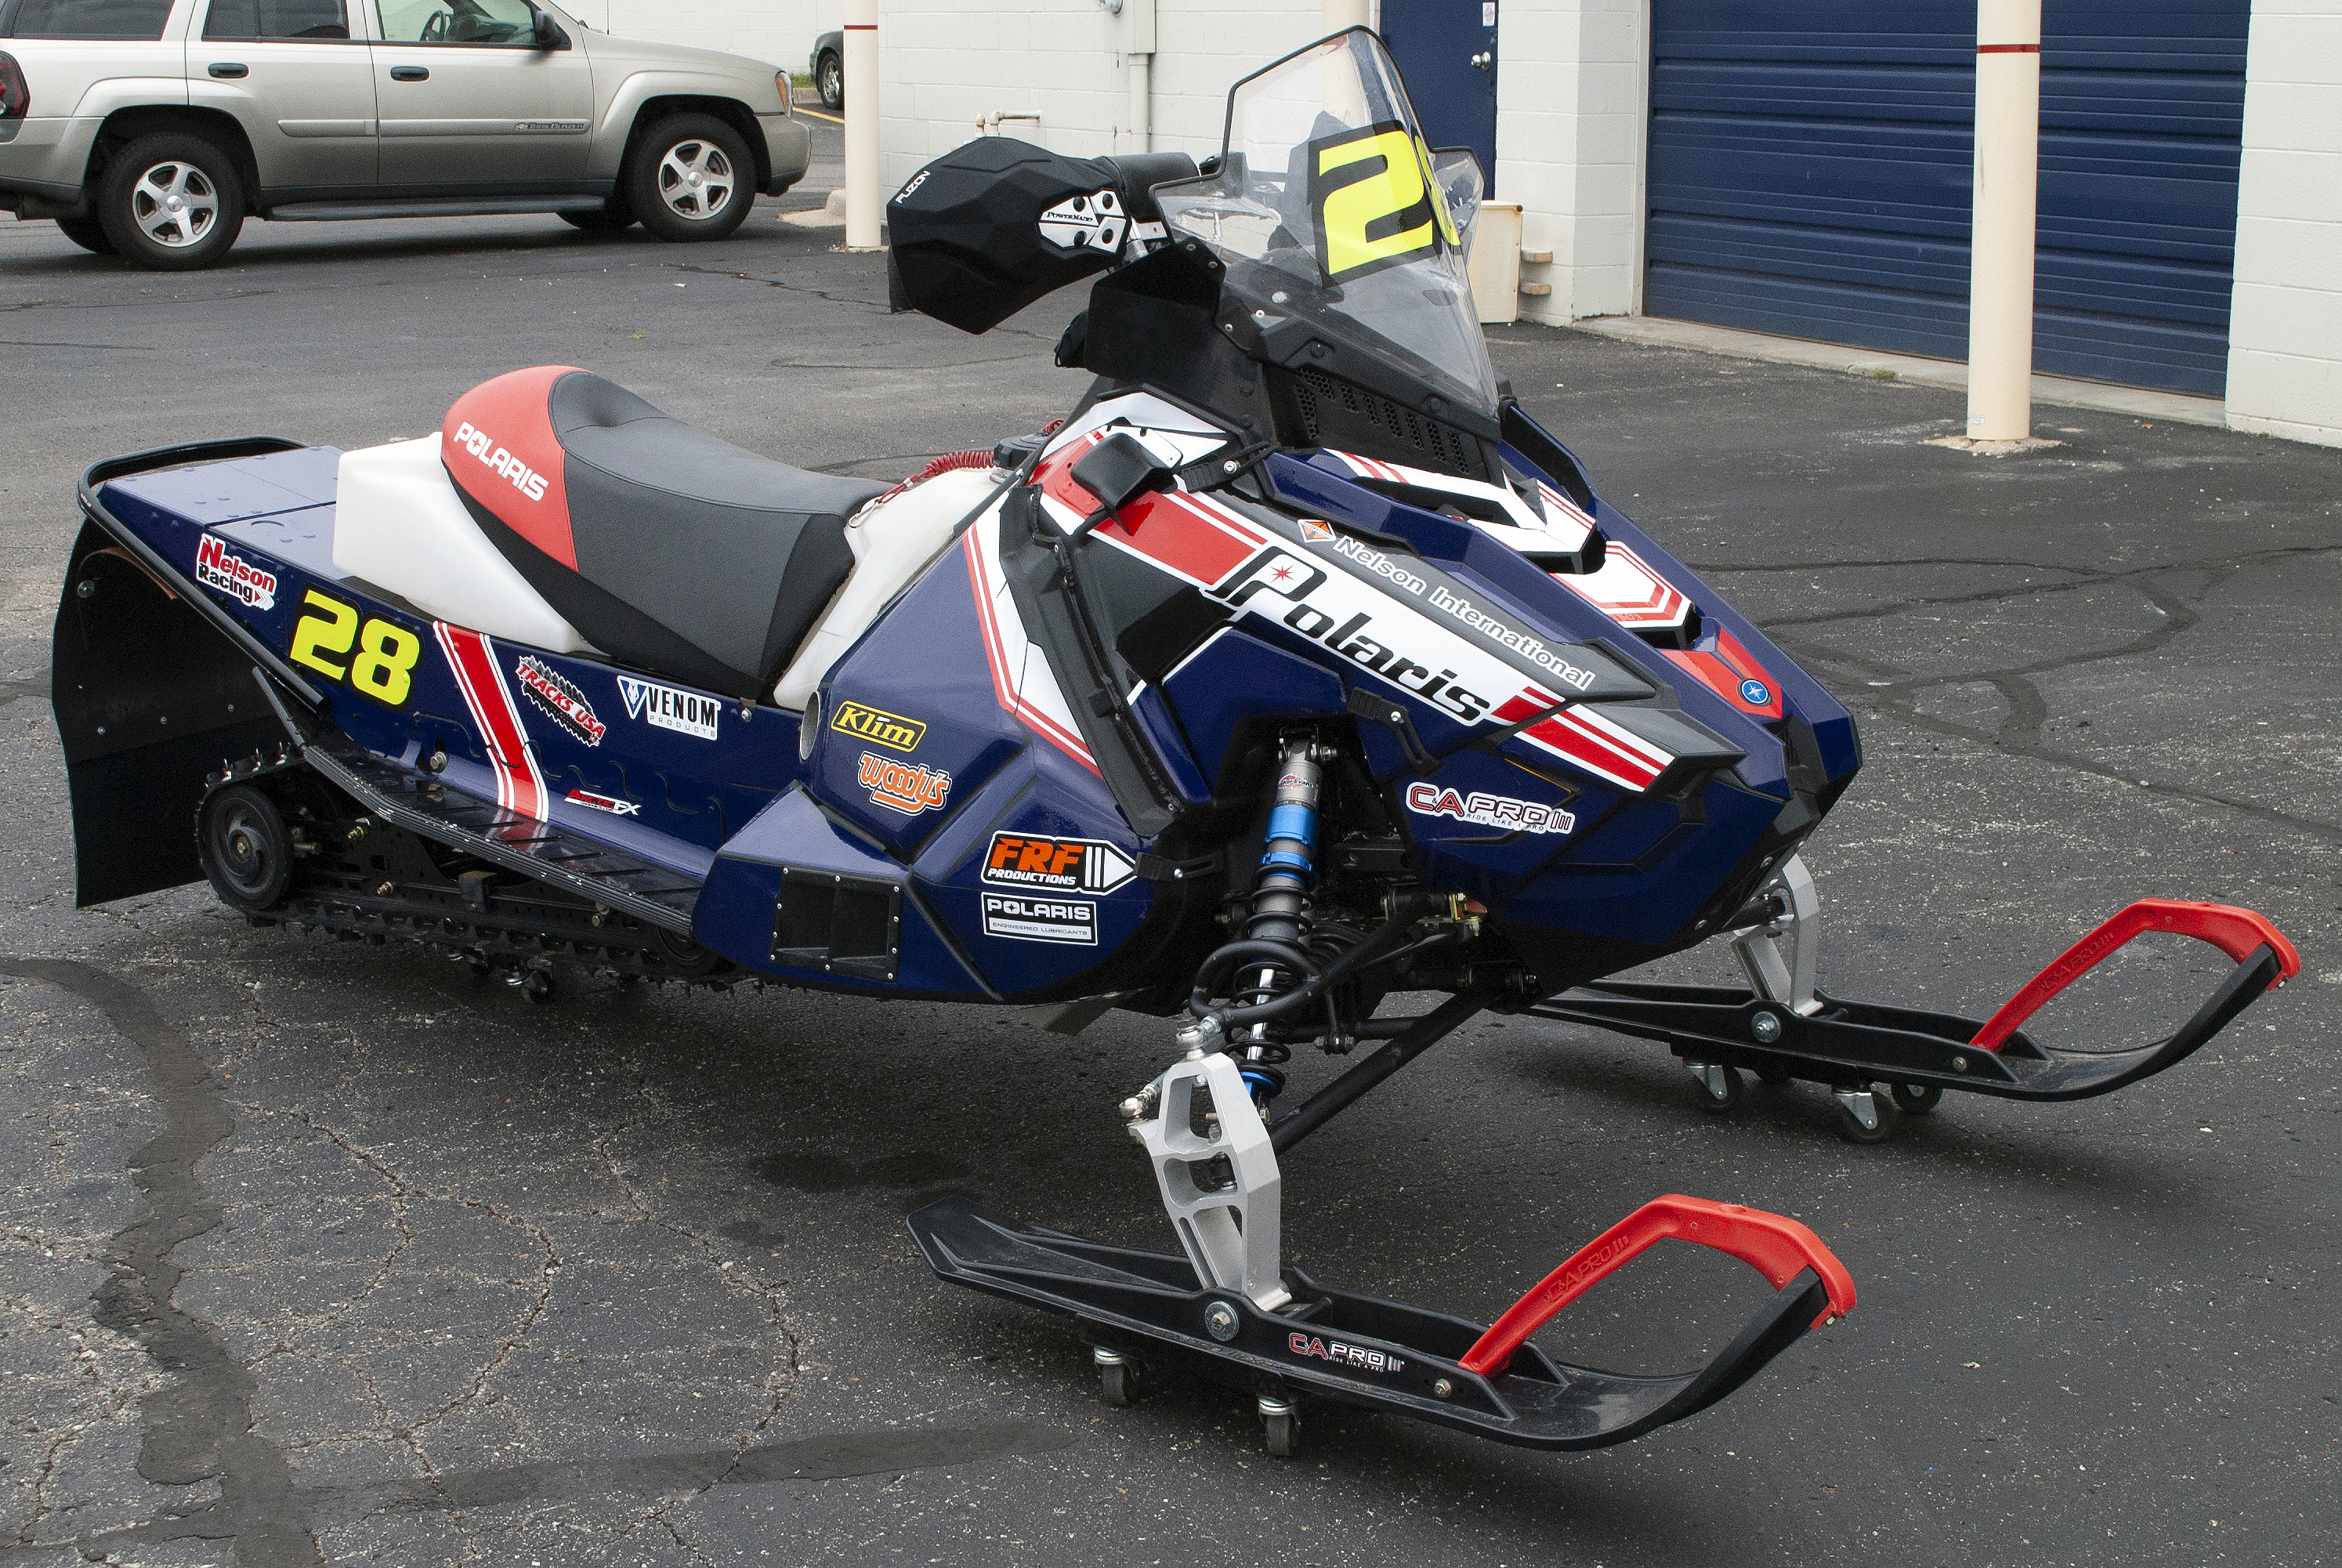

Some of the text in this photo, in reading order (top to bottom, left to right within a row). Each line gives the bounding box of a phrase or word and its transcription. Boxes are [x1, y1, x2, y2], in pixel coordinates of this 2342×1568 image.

[895, 170, 930, 204] FUZON
[453, 422, 548, 502] POLARIS
[198, 563, 253, 603] Racing
[199, 537, 275, 593] Nelson
[1205, 545, 1491, 722] Polaris
[1332, 535, 1596, 692] Nelson International
[291, 589, 420, 705] 28
[518, 663, 606, 739] TRACKS USA
[648, 686, 715, 728] VENOM
[650, 715, 716, 737] PRODUCTS
[837, 706, 916, 747] Klim
[1466, 813, 1487, 822] RIDE
[1491, 817, 1513, 827] LIKE
[987, 867, 1077, 886] PRODUCTIONS
[990, 838, 1085, 875] FRF
[986, 898, 1091, 922] POLARIS
[992, 922, 1088, 936] ENGINEERED LUBRICANTS
